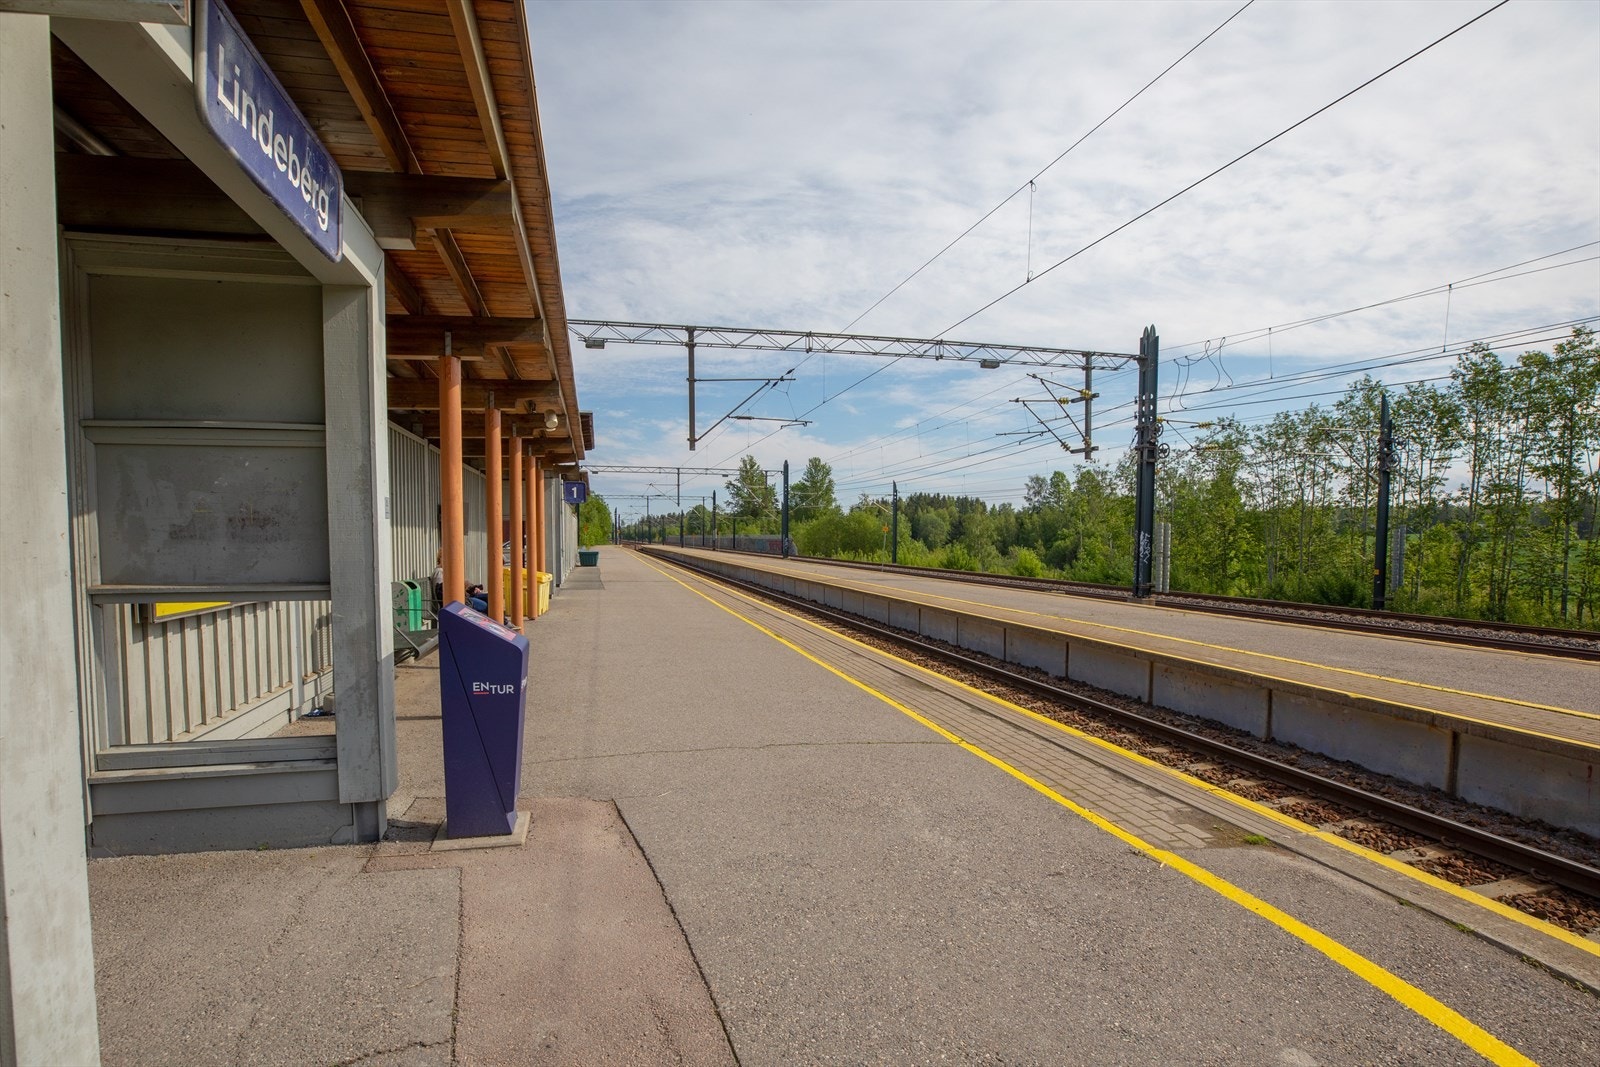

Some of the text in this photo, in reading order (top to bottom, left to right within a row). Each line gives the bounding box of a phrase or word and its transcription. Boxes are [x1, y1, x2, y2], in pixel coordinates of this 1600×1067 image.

[217, 44, 329, 231] Lindeberg
[571, 486, 577, 498] 1
[472, 682, 514, 694] ENTUR
